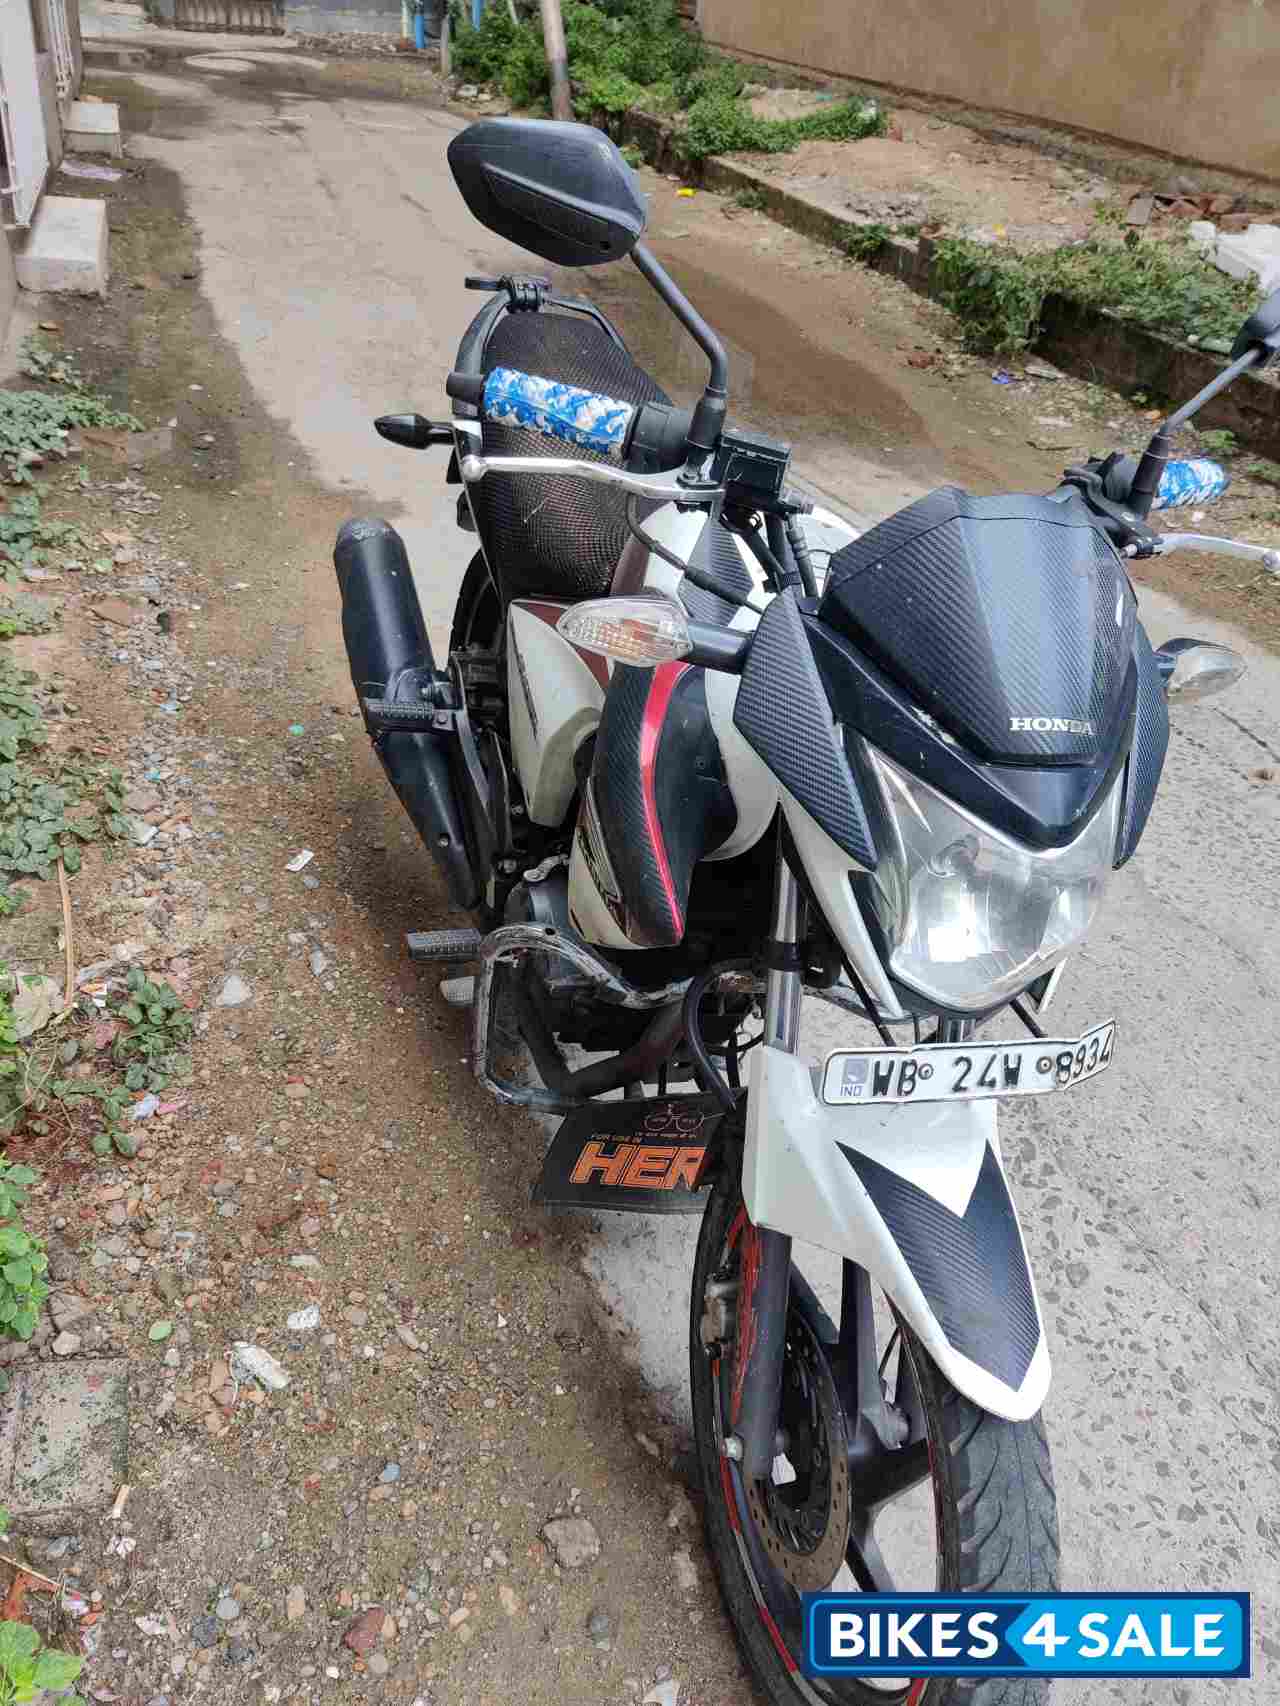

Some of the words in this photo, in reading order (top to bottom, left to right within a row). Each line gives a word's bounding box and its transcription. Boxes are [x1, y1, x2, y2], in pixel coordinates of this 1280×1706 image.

[1009, 717, 1094, 736] HONDA
[872, 1059, 917, 1097] WB
[951, 1053, 1022, 1093] 24W
[1055, 1029, 1115, 1084] 8934
[840, 1083, 862, 1096] IND
